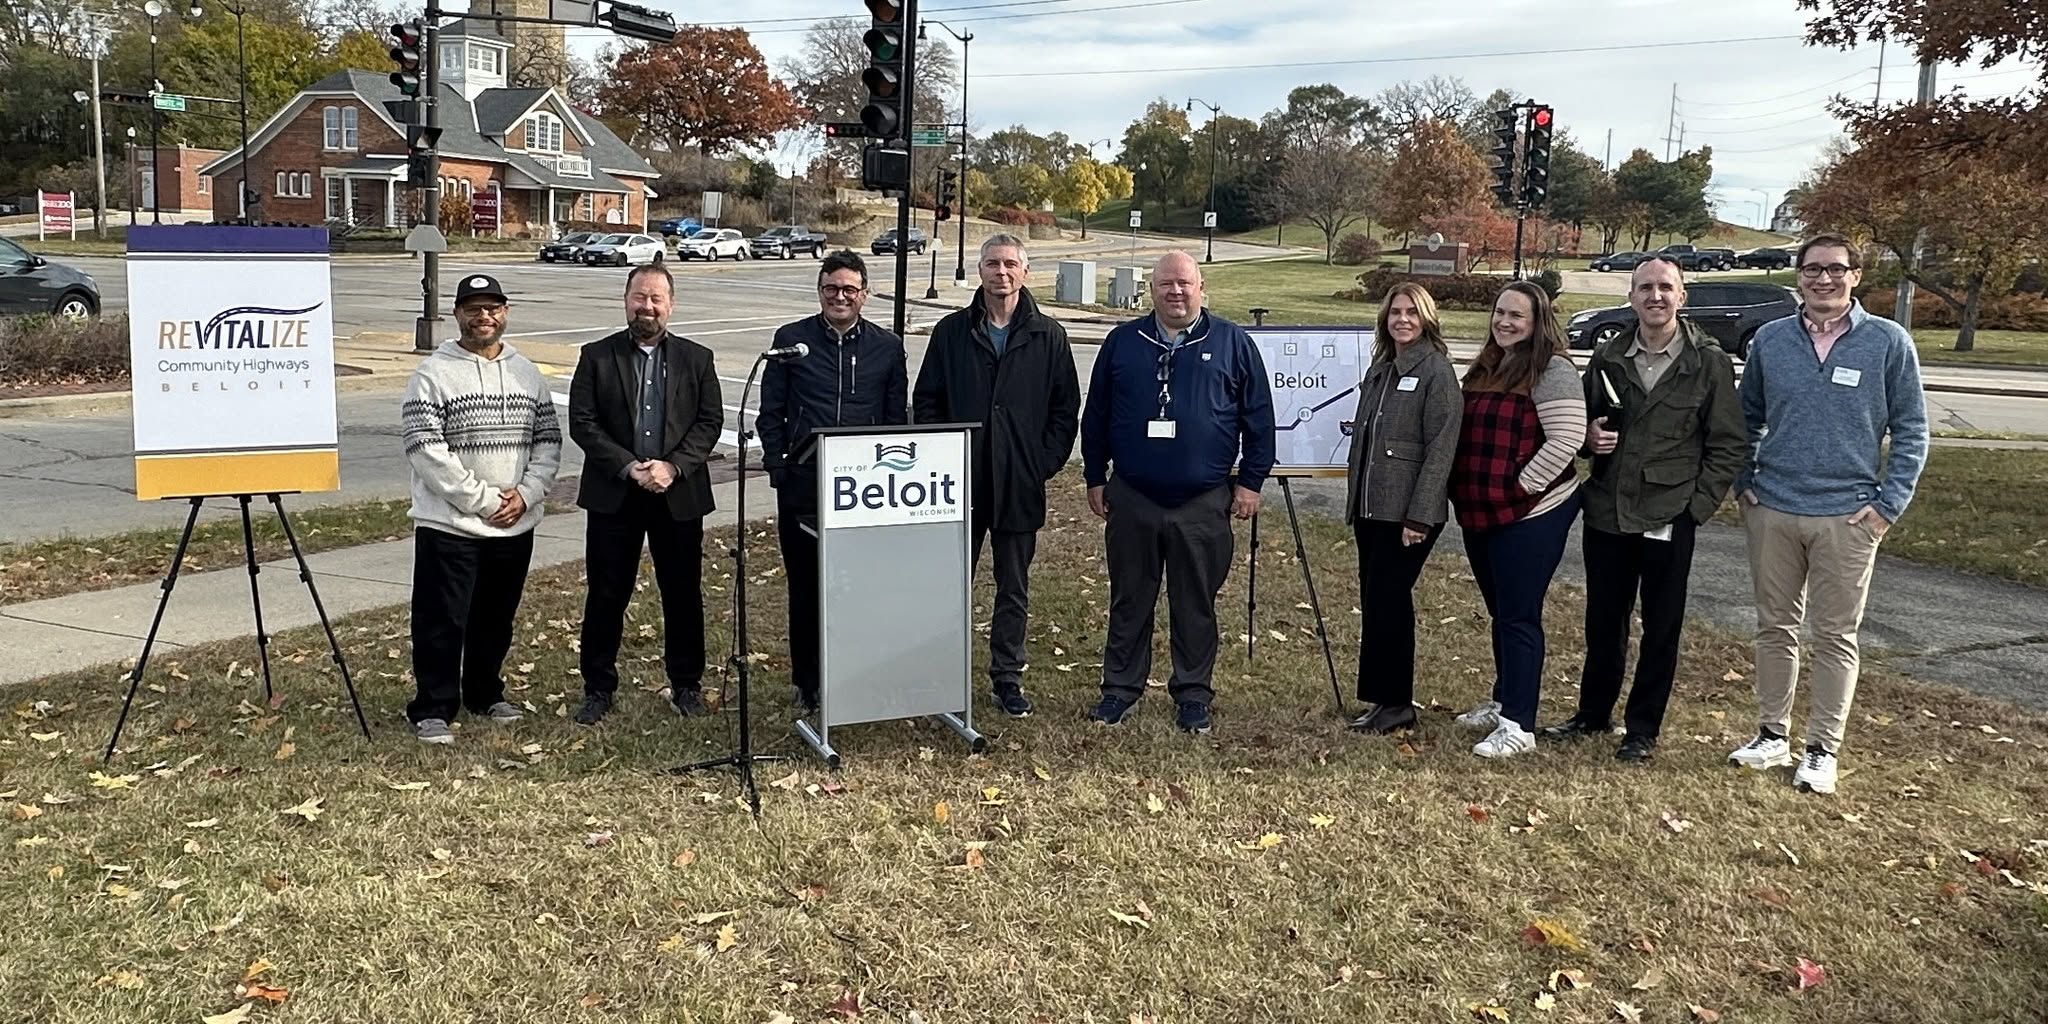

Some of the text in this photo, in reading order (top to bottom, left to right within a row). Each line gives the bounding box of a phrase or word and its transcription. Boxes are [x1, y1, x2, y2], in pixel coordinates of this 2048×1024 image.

[158, 319, 310, 350] REVITALIZE
[1287, 345, 1294, 353] G
[158, 358, 310, 374] Community Highways
[161, 379, 311, 392] BELOIT
[1274, 371, 1328, 389] Beloit
[833, 464, 868, 473] CITY OF
[833, 471, 956, 511] Beloit
[909, 507, 956, 517] WISCONSIN
